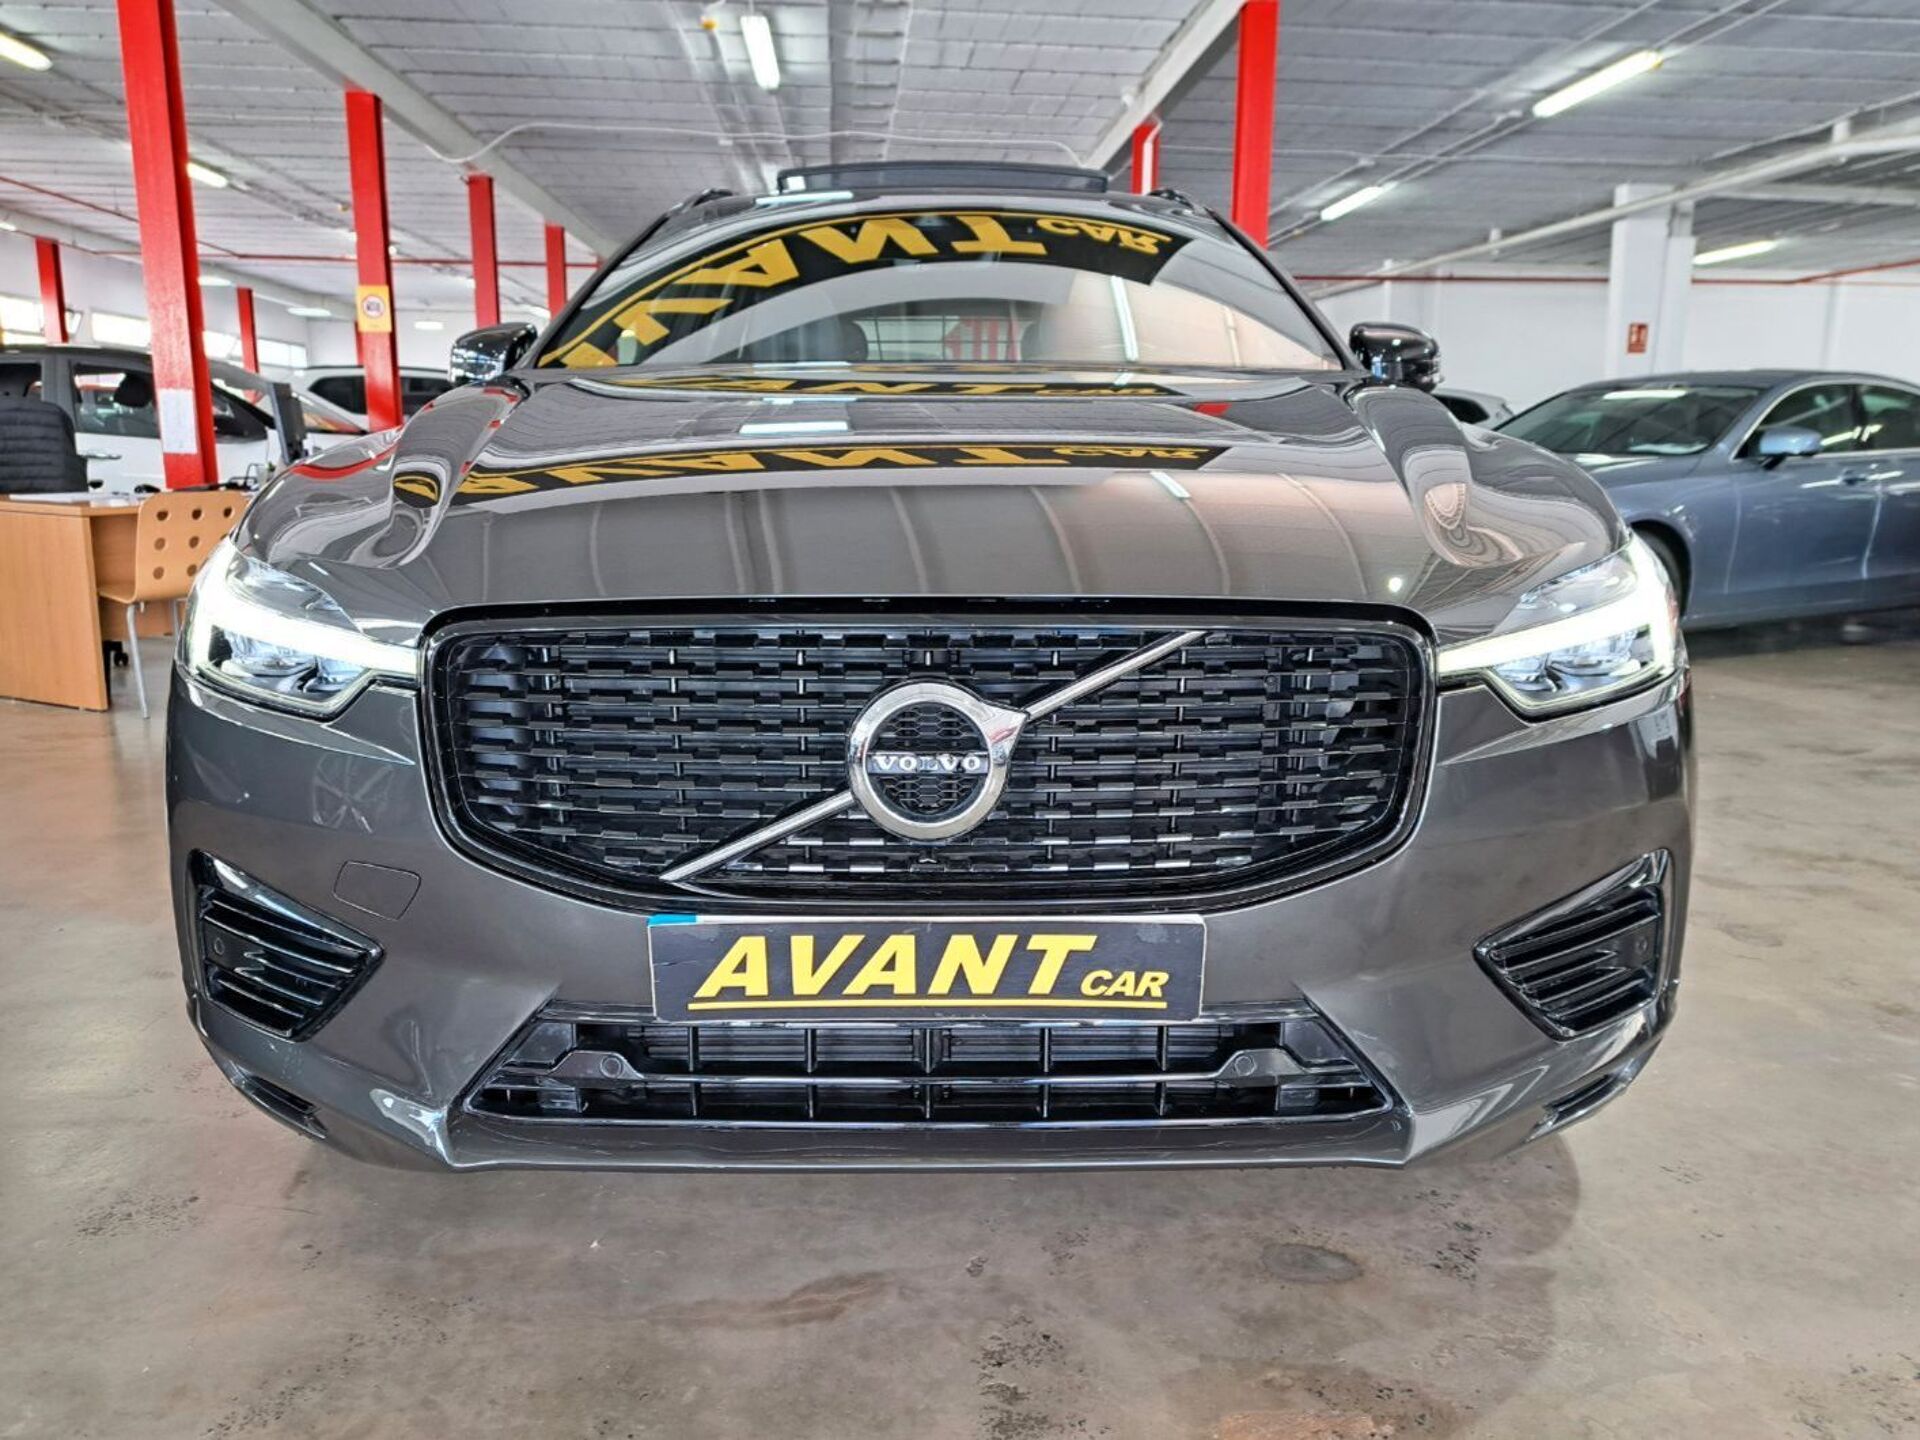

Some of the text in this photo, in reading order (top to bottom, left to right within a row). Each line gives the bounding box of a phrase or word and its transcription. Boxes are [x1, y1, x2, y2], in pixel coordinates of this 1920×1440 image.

[873, 755, 981, 771] VOLVO
[694, 934, 1170, 998] AVANT CAR
